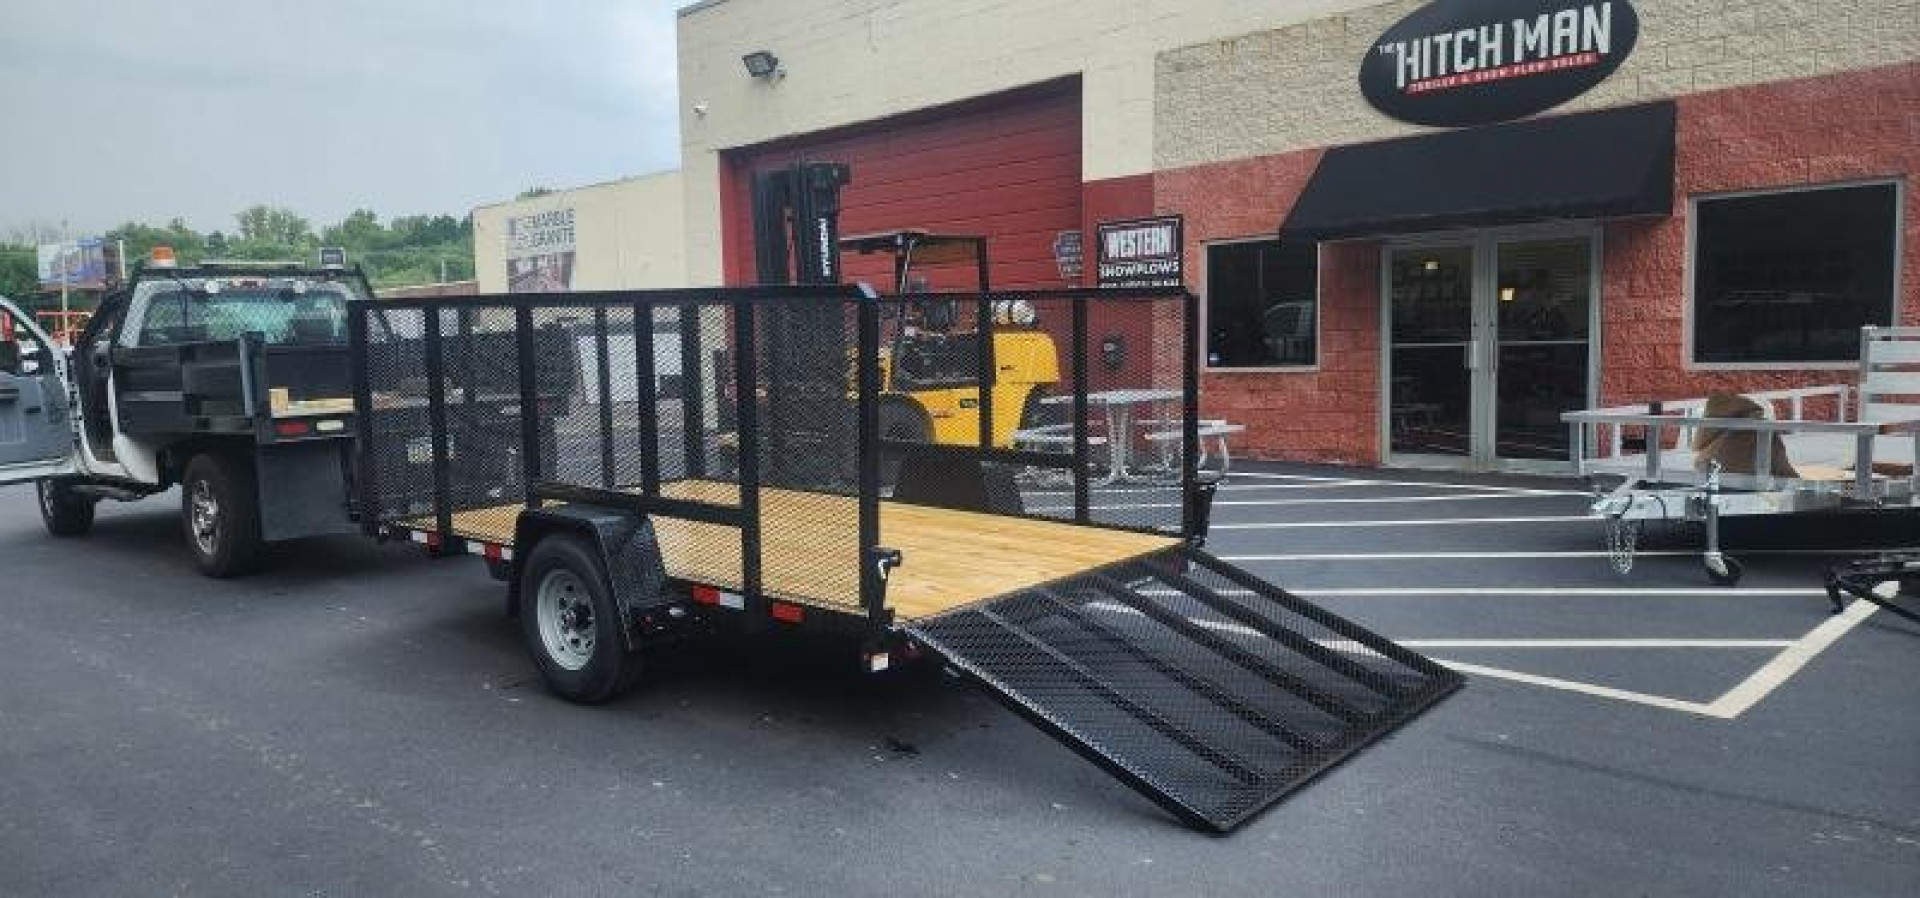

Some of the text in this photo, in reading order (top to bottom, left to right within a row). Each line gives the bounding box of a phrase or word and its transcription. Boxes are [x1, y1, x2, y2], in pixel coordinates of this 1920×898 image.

[1396, 2, 1611, 89] HITCH MAN
[1512, 60, 1547, 75] PLOW
[1551, 52, 1599, 71] SALES
[818, 217, 831, 277] HYUNDAI
[1106, 225, 1172, 258] WESTERN
